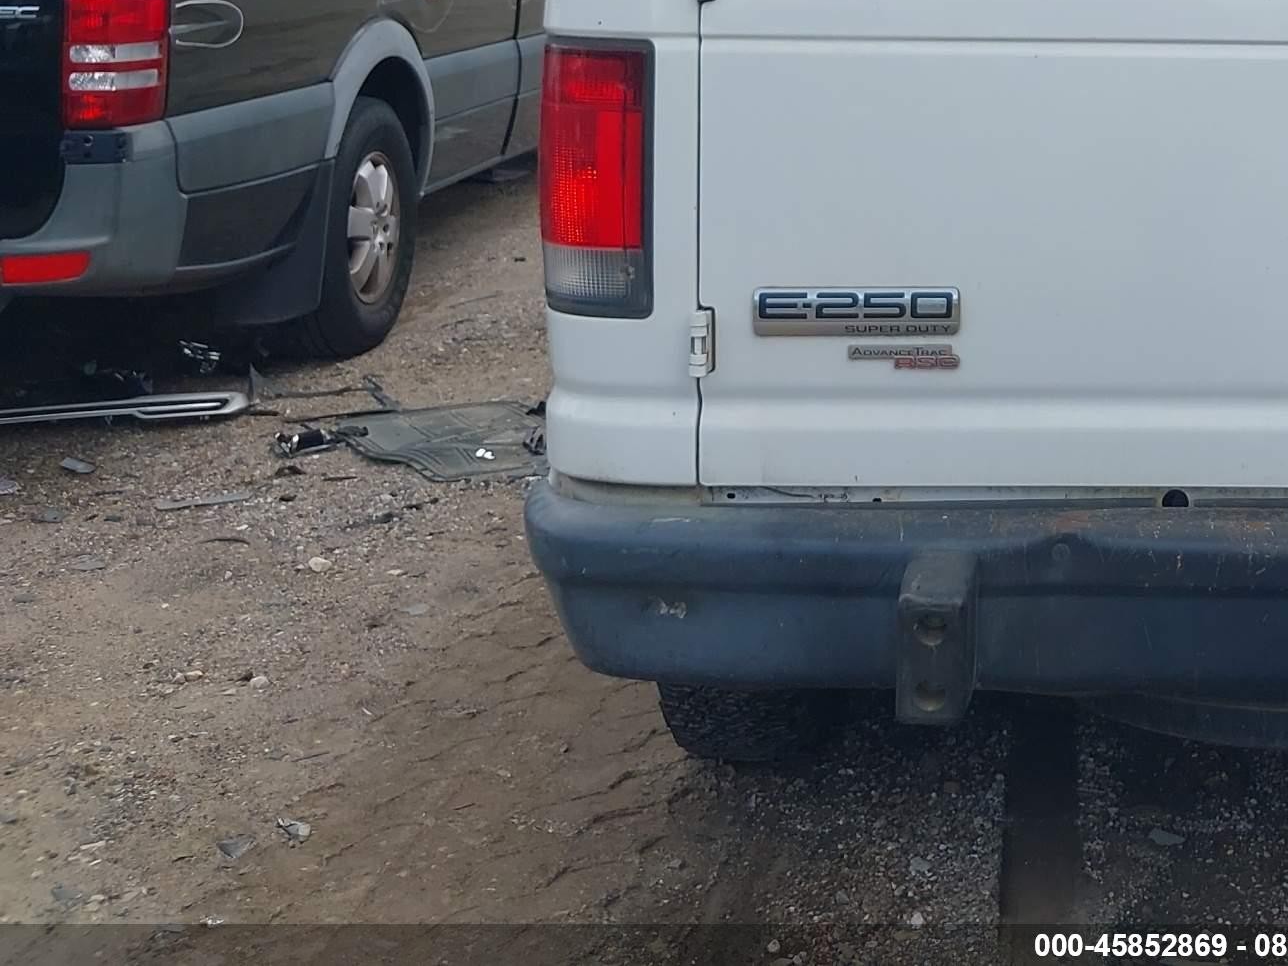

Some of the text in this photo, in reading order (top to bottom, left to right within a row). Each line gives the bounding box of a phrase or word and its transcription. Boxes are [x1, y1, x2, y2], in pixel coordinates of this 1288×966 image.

[757, 291, 954, 320] E-250
[844, 324, 951, 334] SUPER DUTY
[894, 356, 960, 369] RSC
